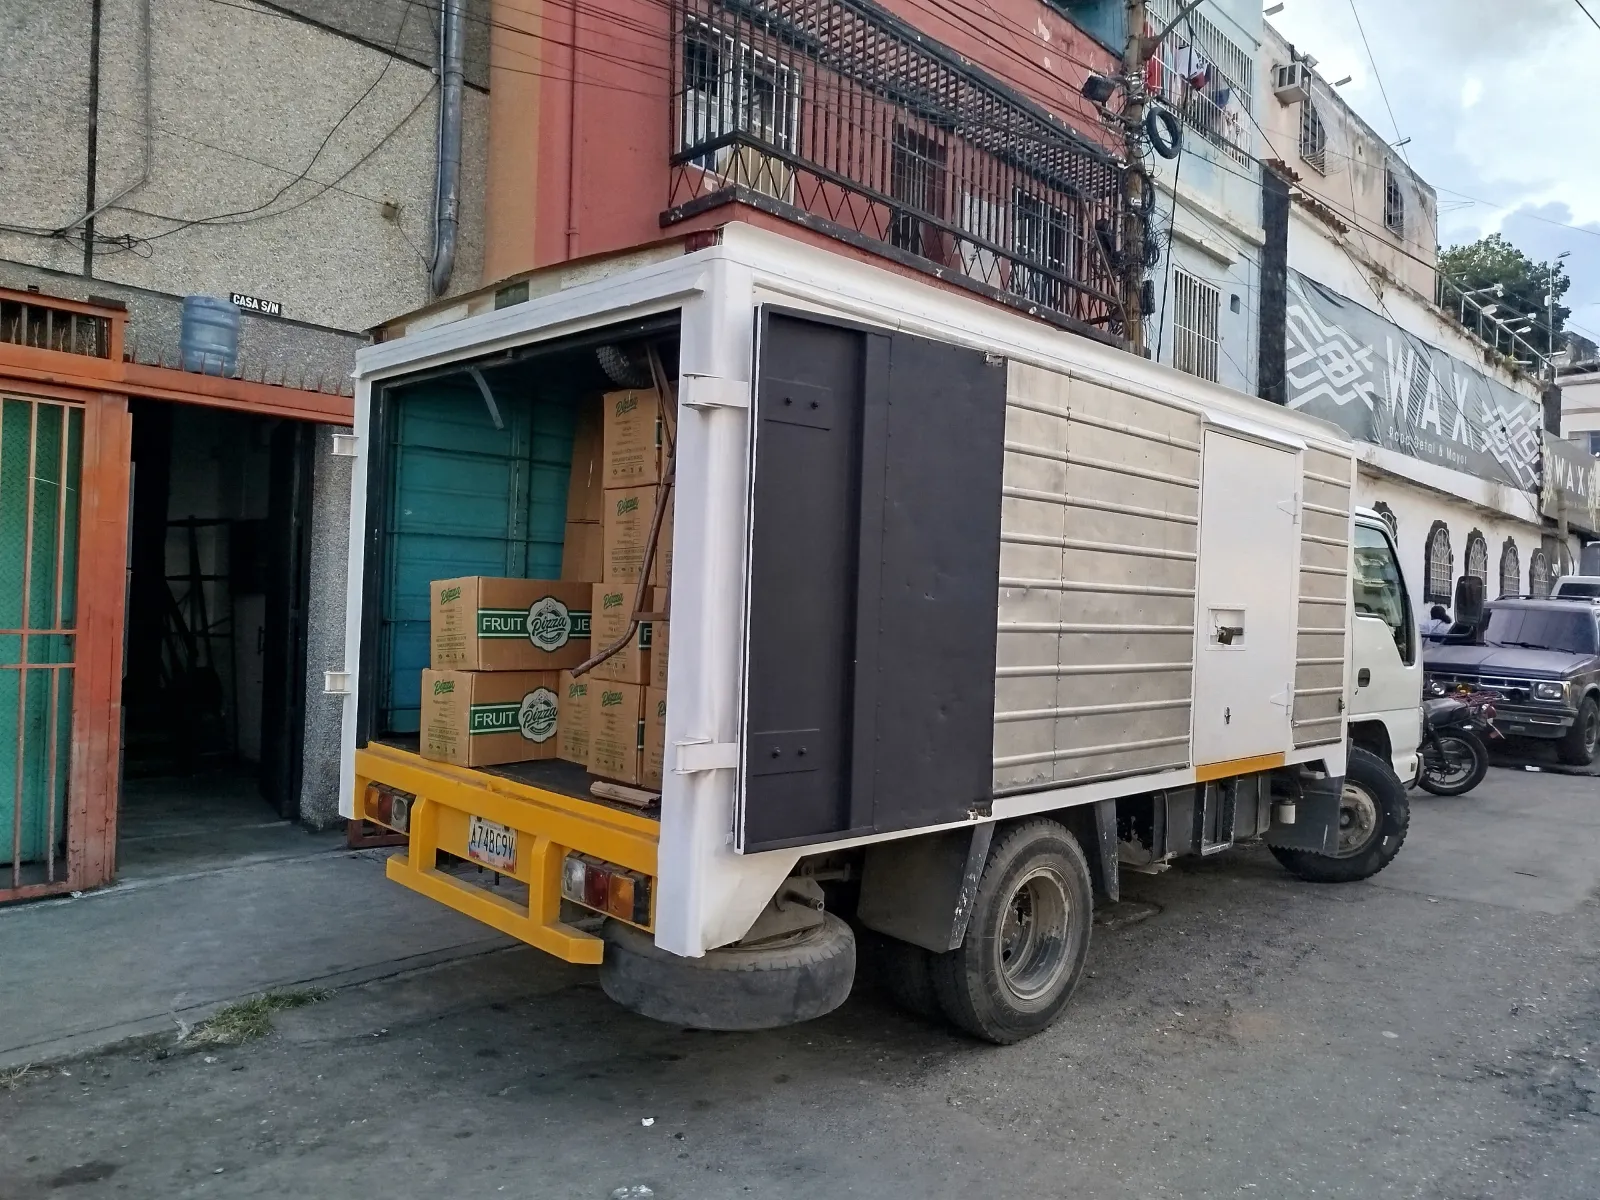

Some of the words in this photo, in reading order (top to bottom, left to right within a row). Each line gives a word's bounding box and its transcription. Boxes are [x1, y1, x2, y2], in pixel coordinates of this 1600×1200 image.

[233, 294, 259, 309] CASA
[260, 300, 279, 314] S/N
[1385, 335, 1470, 447] WAX
[1554, 454, 1586, 496] WAX
[482, 617, 524, 631] FRUIT
[531, 615, 568, 637] Pizza
[574, 618, 592, 631] JE
[474, 711, 516, 727] FRUIT
[522, 706, 557, 730] Pizza
[470, 823, 514, 860] A74BC9V
